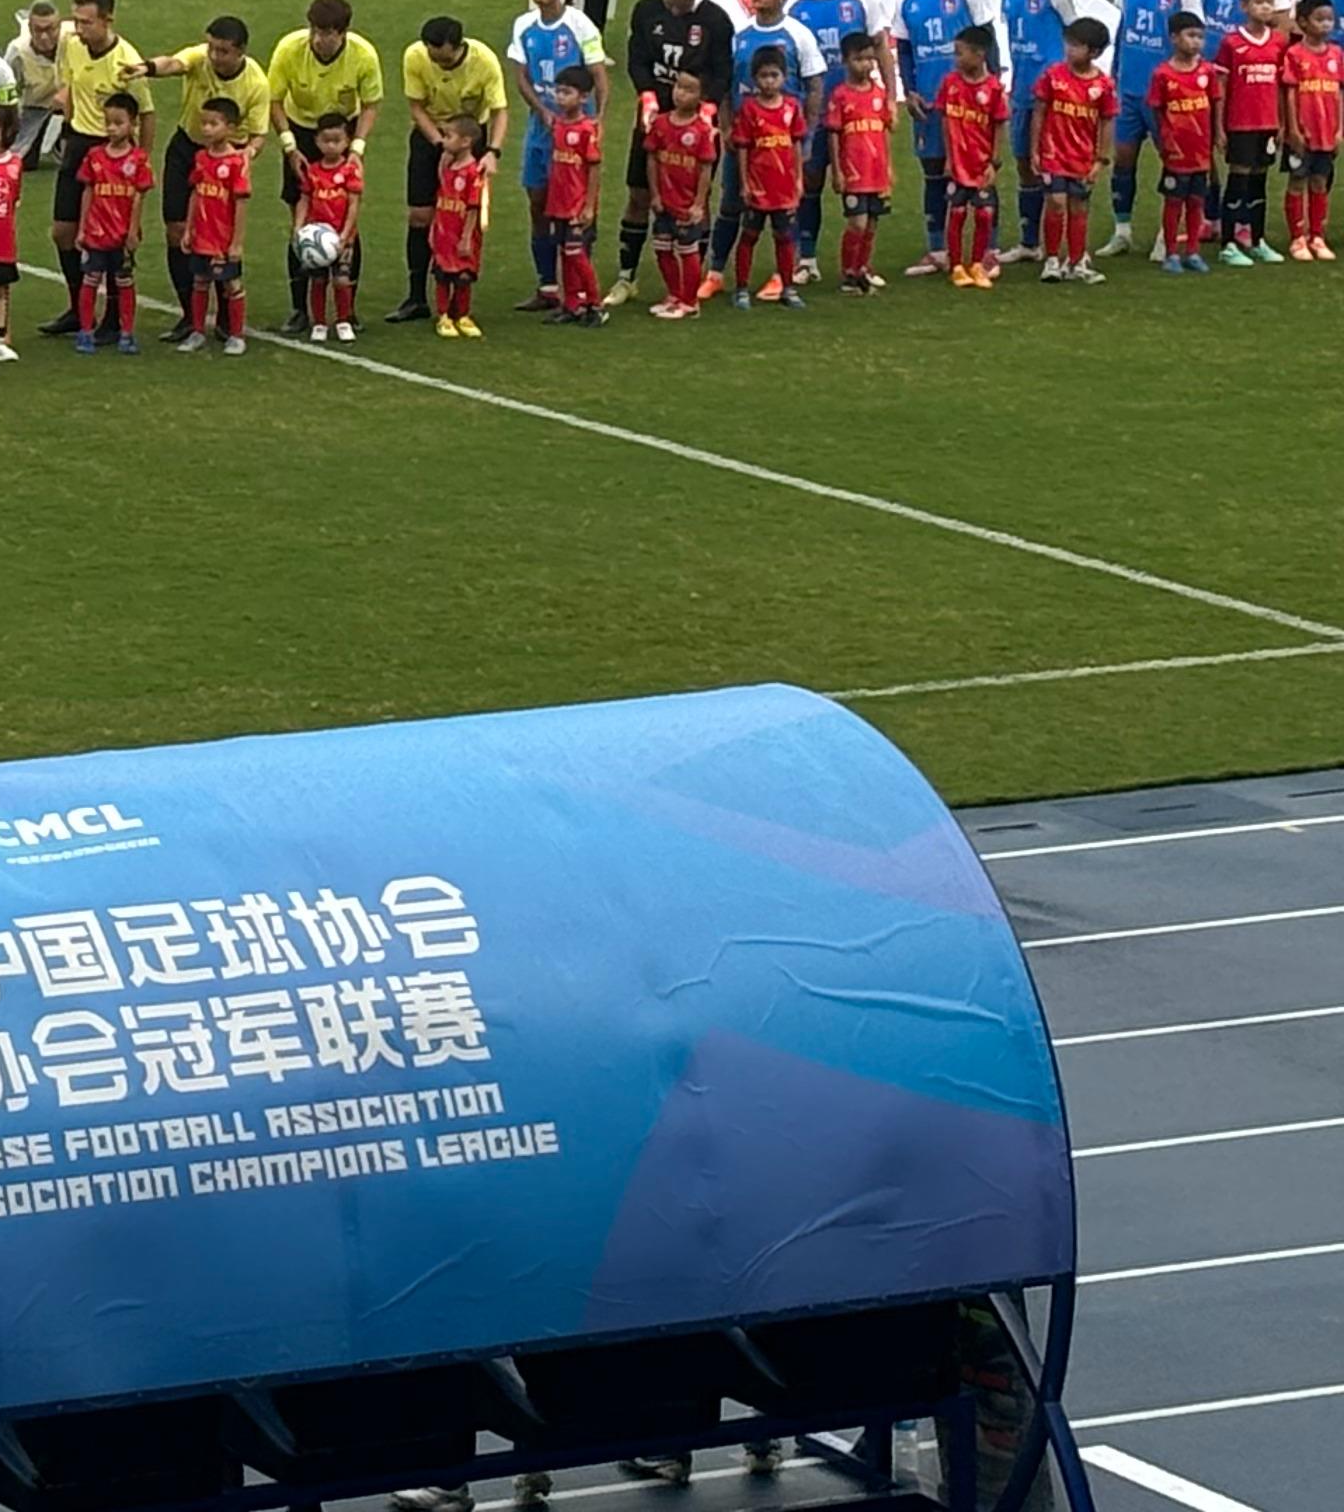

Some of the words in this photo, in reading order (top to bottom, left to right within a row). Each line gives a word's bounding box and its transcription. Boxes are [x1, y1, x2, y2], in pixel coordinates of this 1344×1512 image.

[663, 44, 684, 67] 77
[65, 1110, 256, 1162] FOOTBALL
[264, 1083, 505, 1140] ASSOCIATION
[190, 1138, 407, 1195] CHAMPIONS
[418, 1120, 560, 1169] LEAGUE
